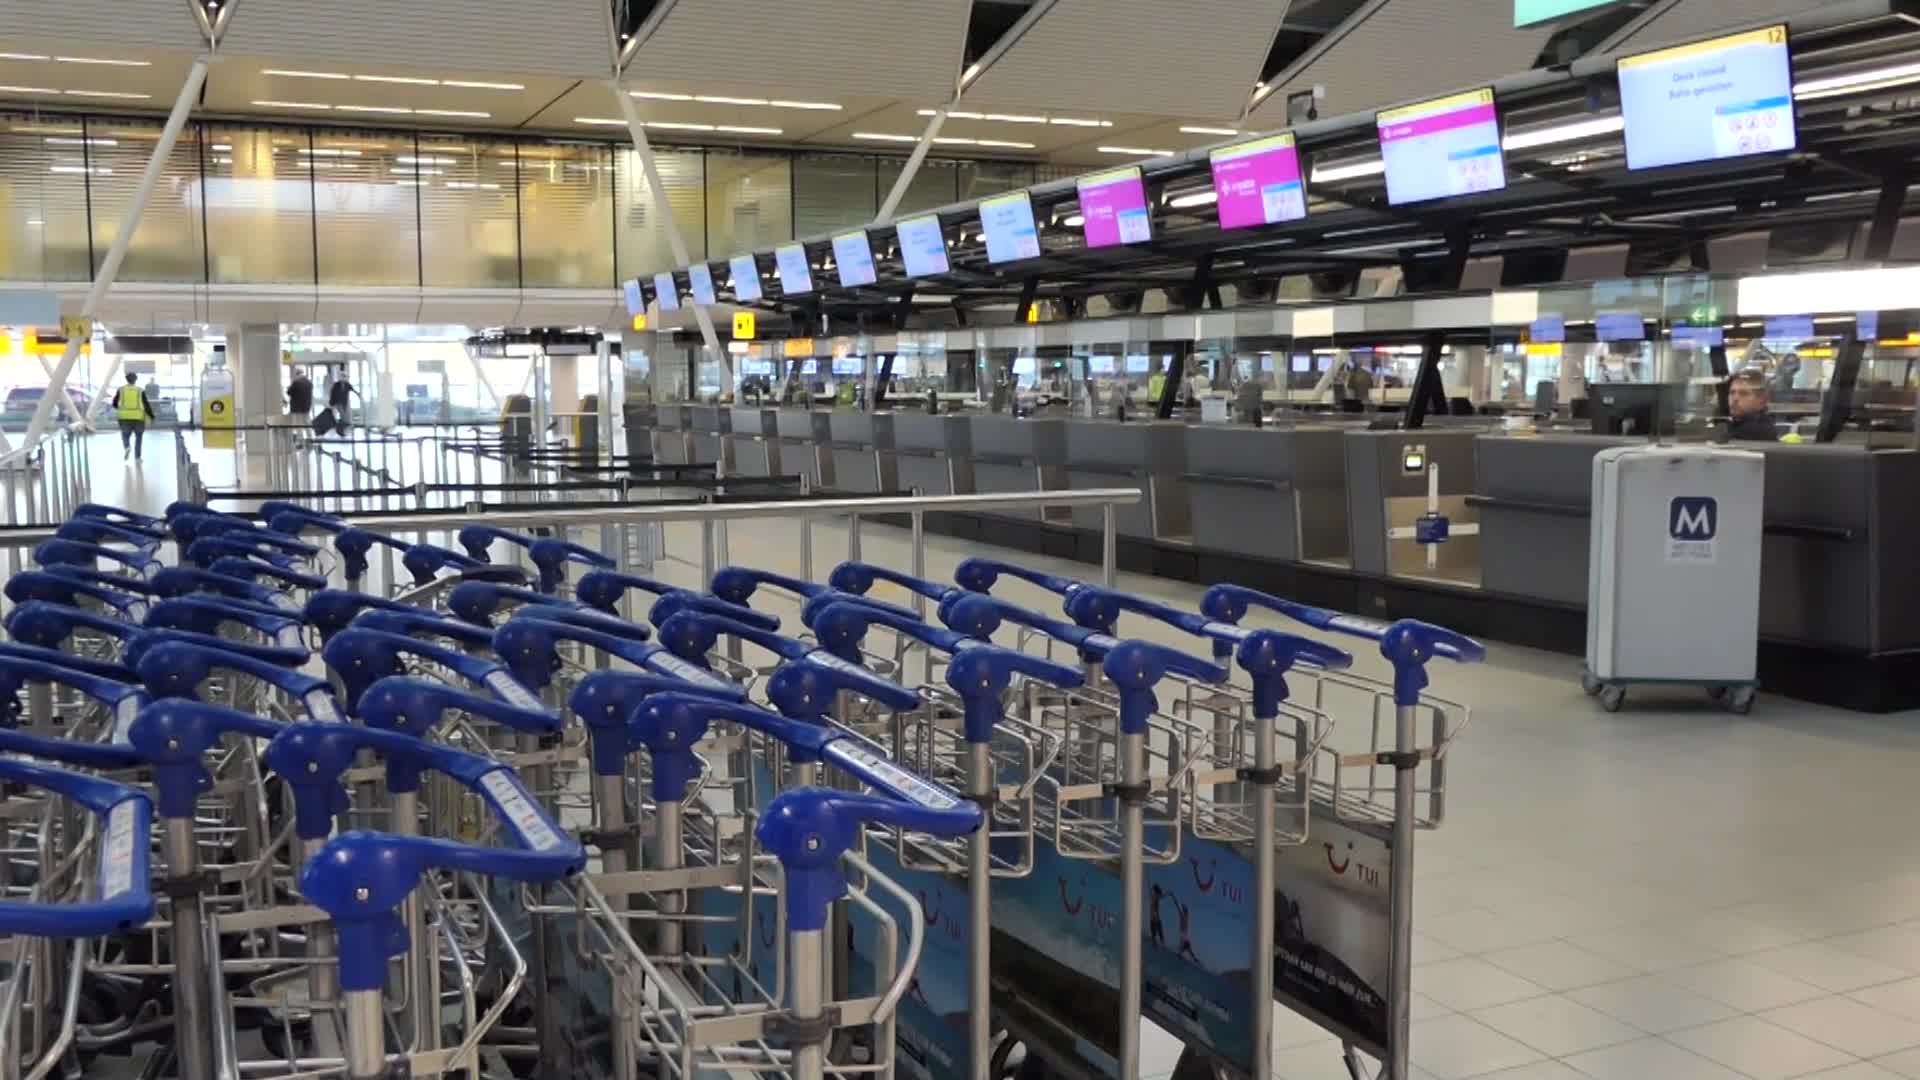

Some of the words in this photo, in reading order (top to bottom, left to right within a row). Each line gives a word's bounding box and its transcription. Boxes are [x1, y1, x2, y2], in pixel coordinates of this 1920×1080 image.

[1767, 29, 1783, 43] 12
[1674, 502, 1710, 535] M
[1355, 863, 1379, 889] TUI
[1222, 879, 1242, 905] TUI
